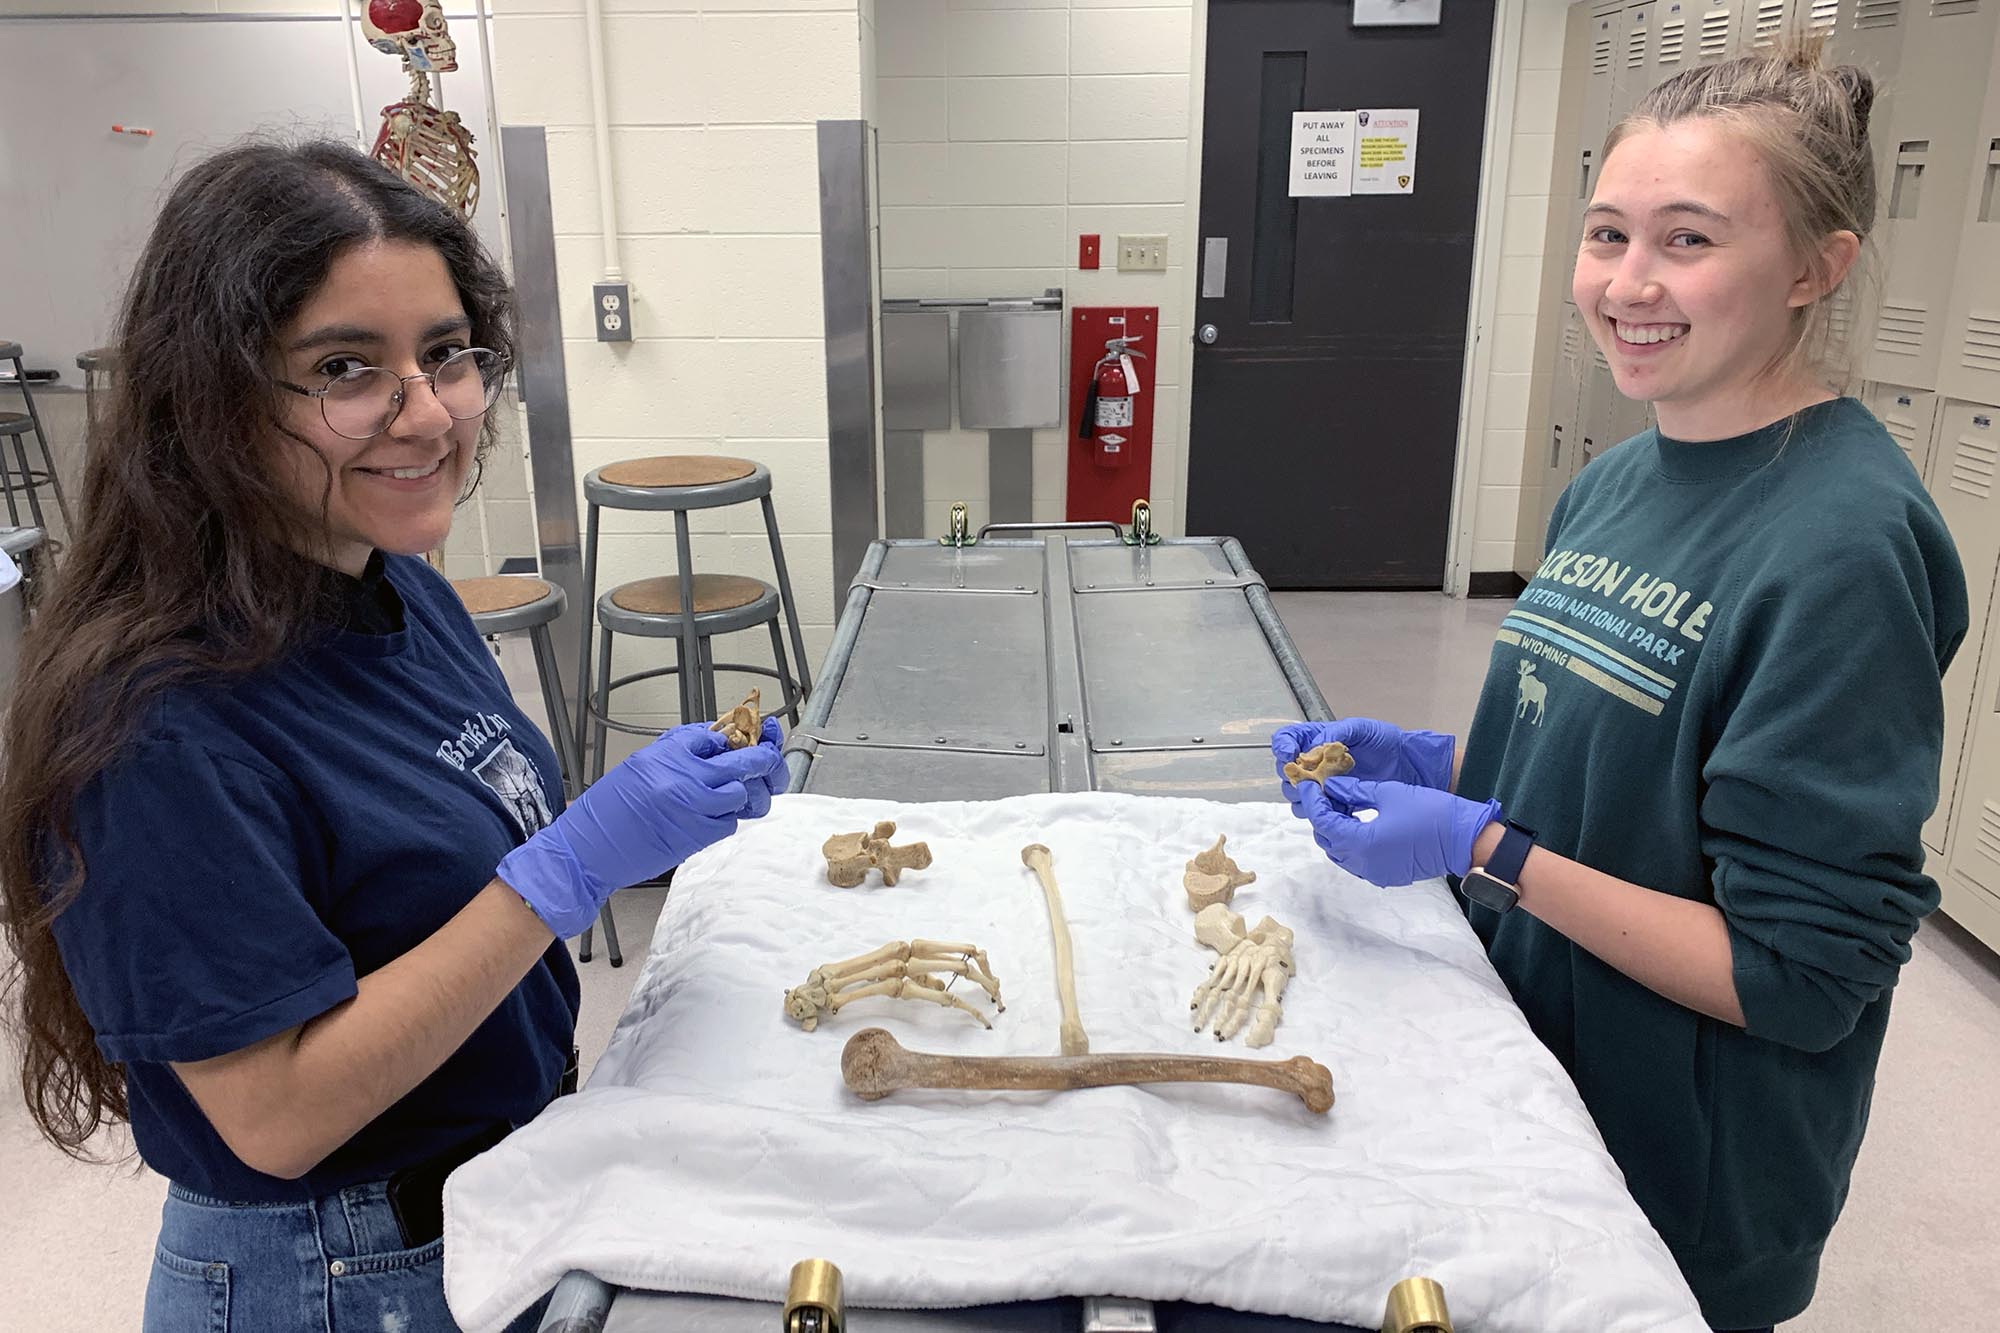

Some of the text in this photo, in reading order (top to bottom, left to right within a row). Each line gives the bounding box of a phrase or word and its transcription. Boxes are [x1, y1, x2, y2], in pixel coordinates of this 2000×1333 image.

[1302, 121, 1345, 130] PUT AWAY
[1315, 134, 1330, 142] ALL
[1300, 146, 1345, 155] SPECIMENS
[1306, 159, 1336, 168] BEFORE
[1304, 171, 1338, 180] LEAVING
[1535, 548, 1714, 642] ACKSON HOLE
[1529, 587, 1686, 666] TETON NATIONAL PARK
[1520, 634, 1569, 667] WYOMING
